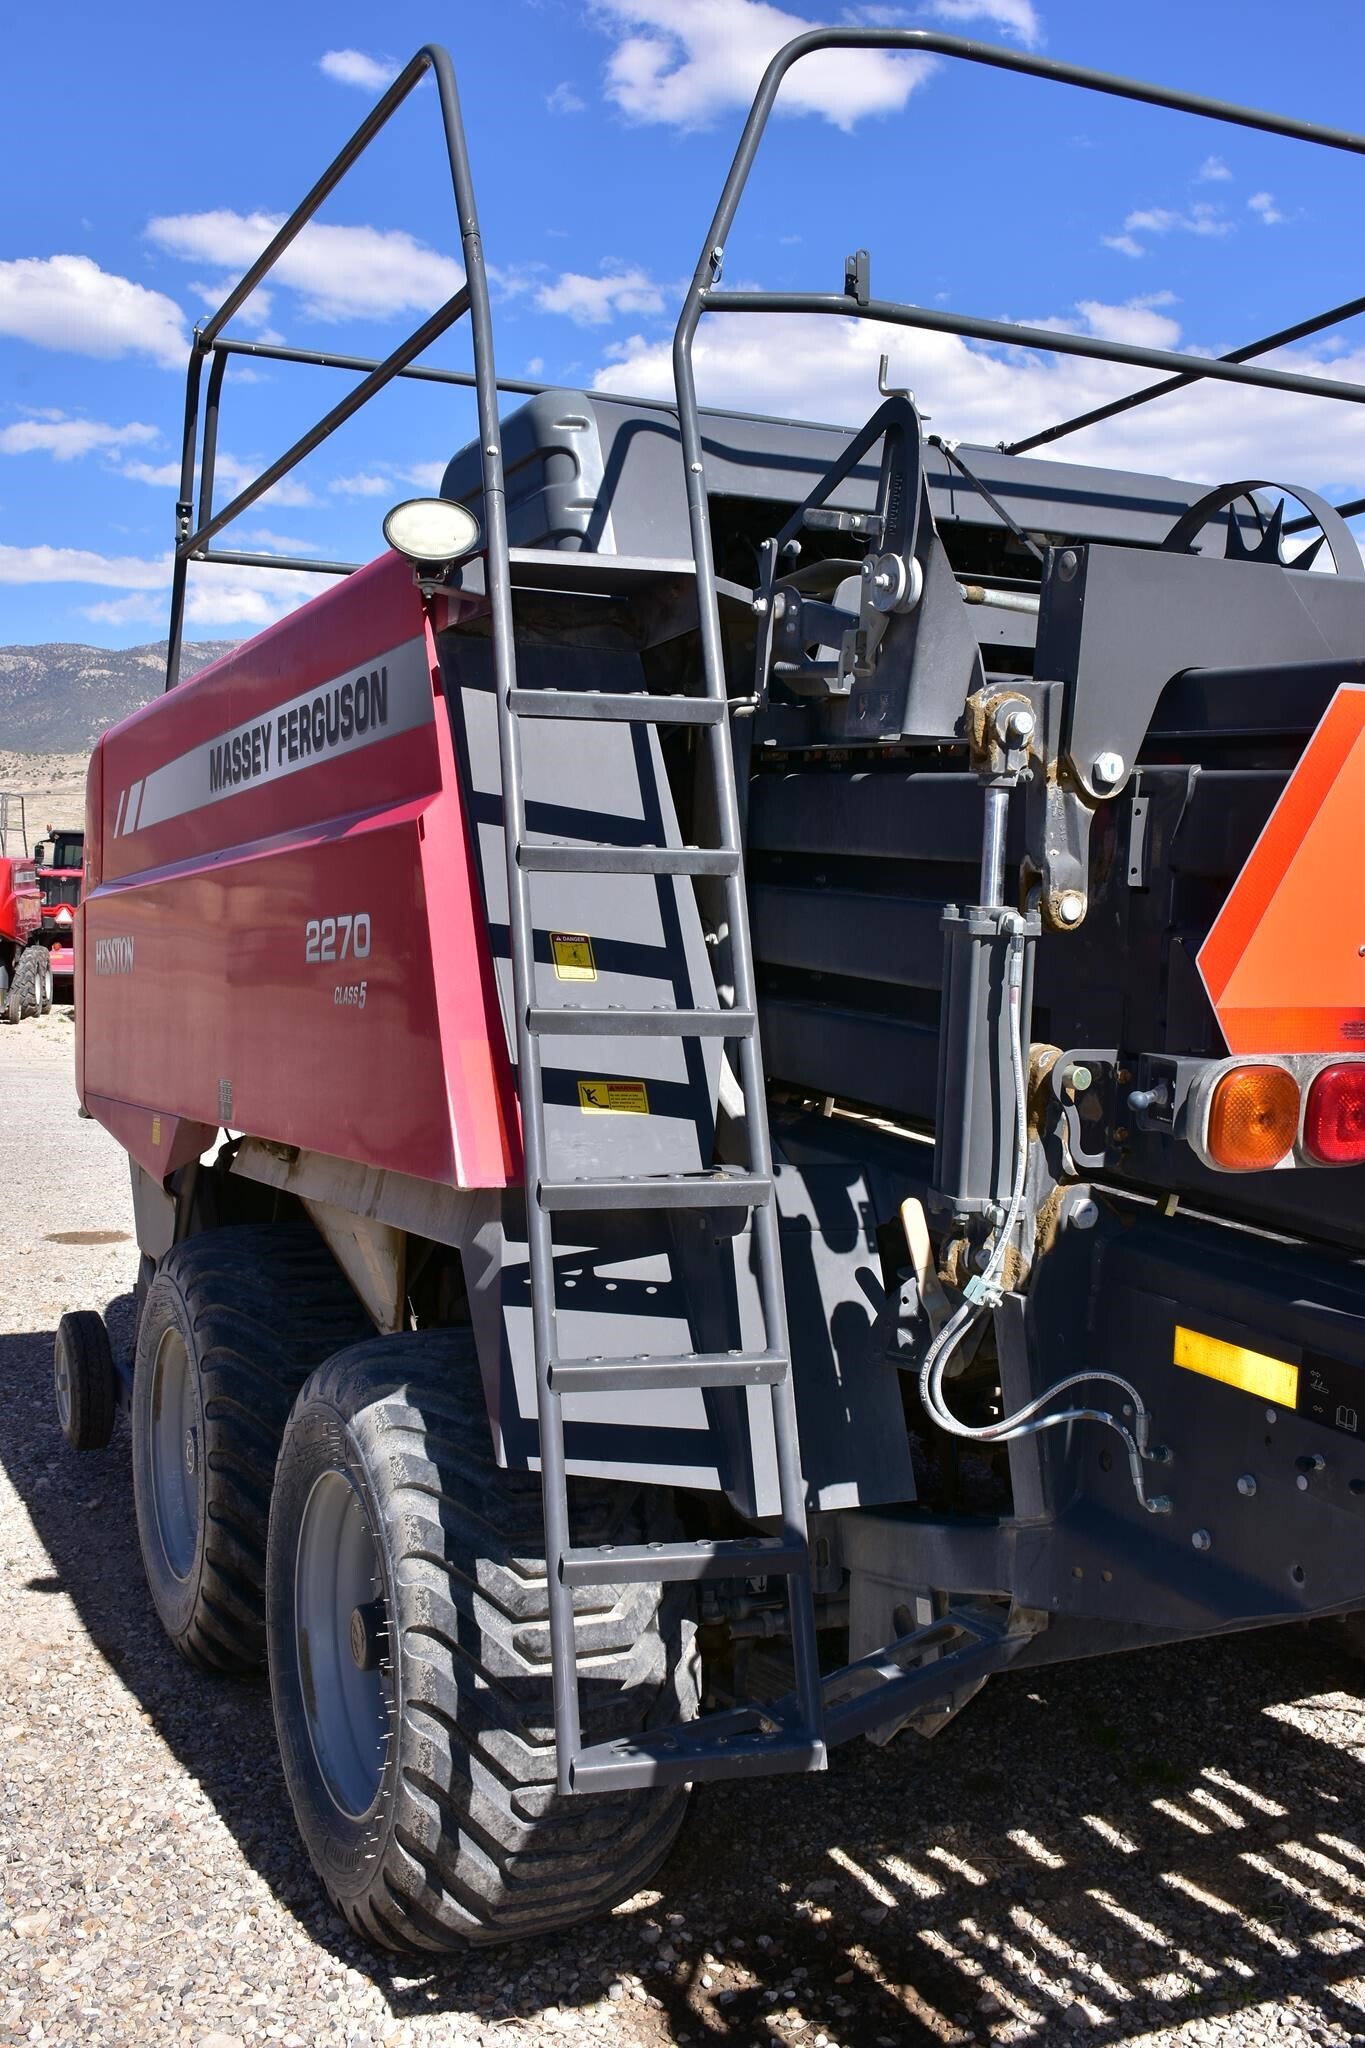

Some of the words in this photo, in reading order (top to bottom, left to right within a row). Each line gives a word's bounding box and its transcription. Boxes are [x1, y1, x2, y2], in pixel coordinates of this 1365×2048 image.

[209, 721, 273, 794] MASSEY
[277, 666, 389, 767] FERGUSON
[95, 935, 135, 976] HESSTON
[304, 912, 372, 964] 2270
